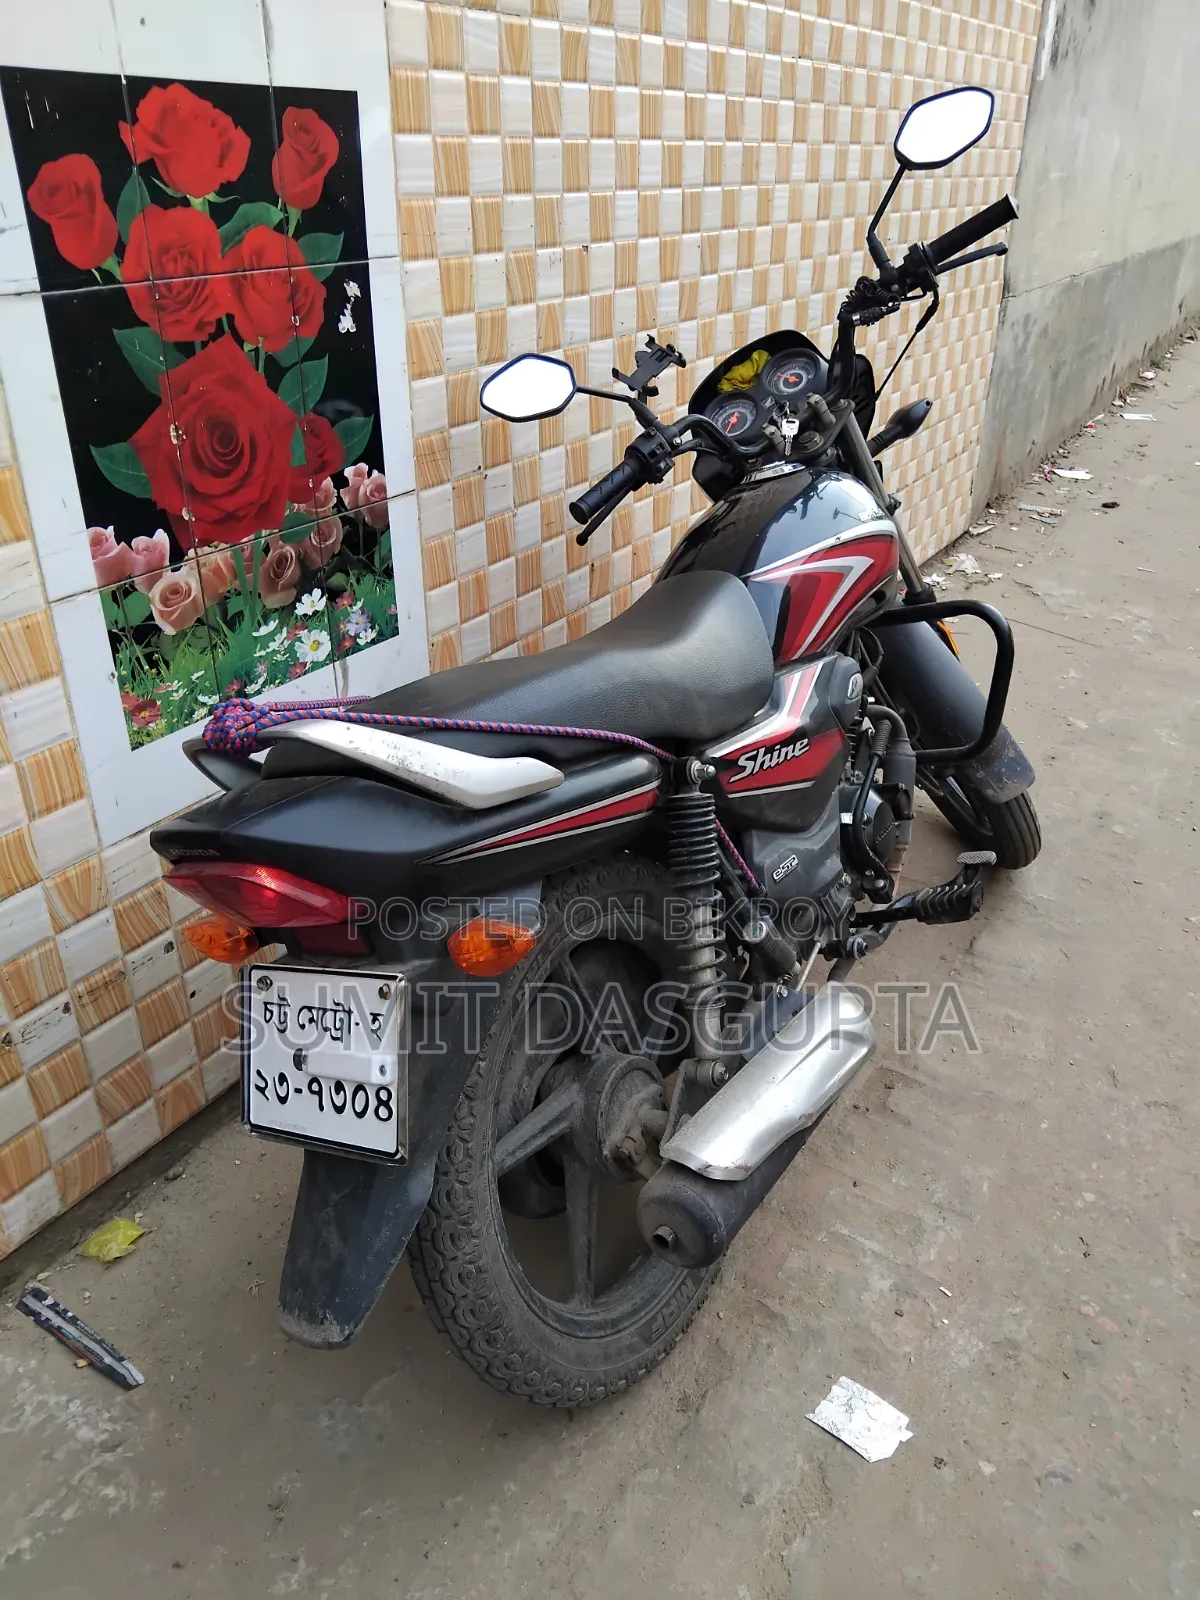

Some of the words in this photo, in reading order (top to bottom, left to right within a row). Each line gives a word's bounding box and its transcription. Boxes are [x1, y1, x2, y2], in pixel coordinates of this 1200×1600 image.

[728, 737, 810, 784] Shine
[169, 848, 220, 857] HONDA
[254, 1068, 394, 1122] ২৩-৭৩০৪
